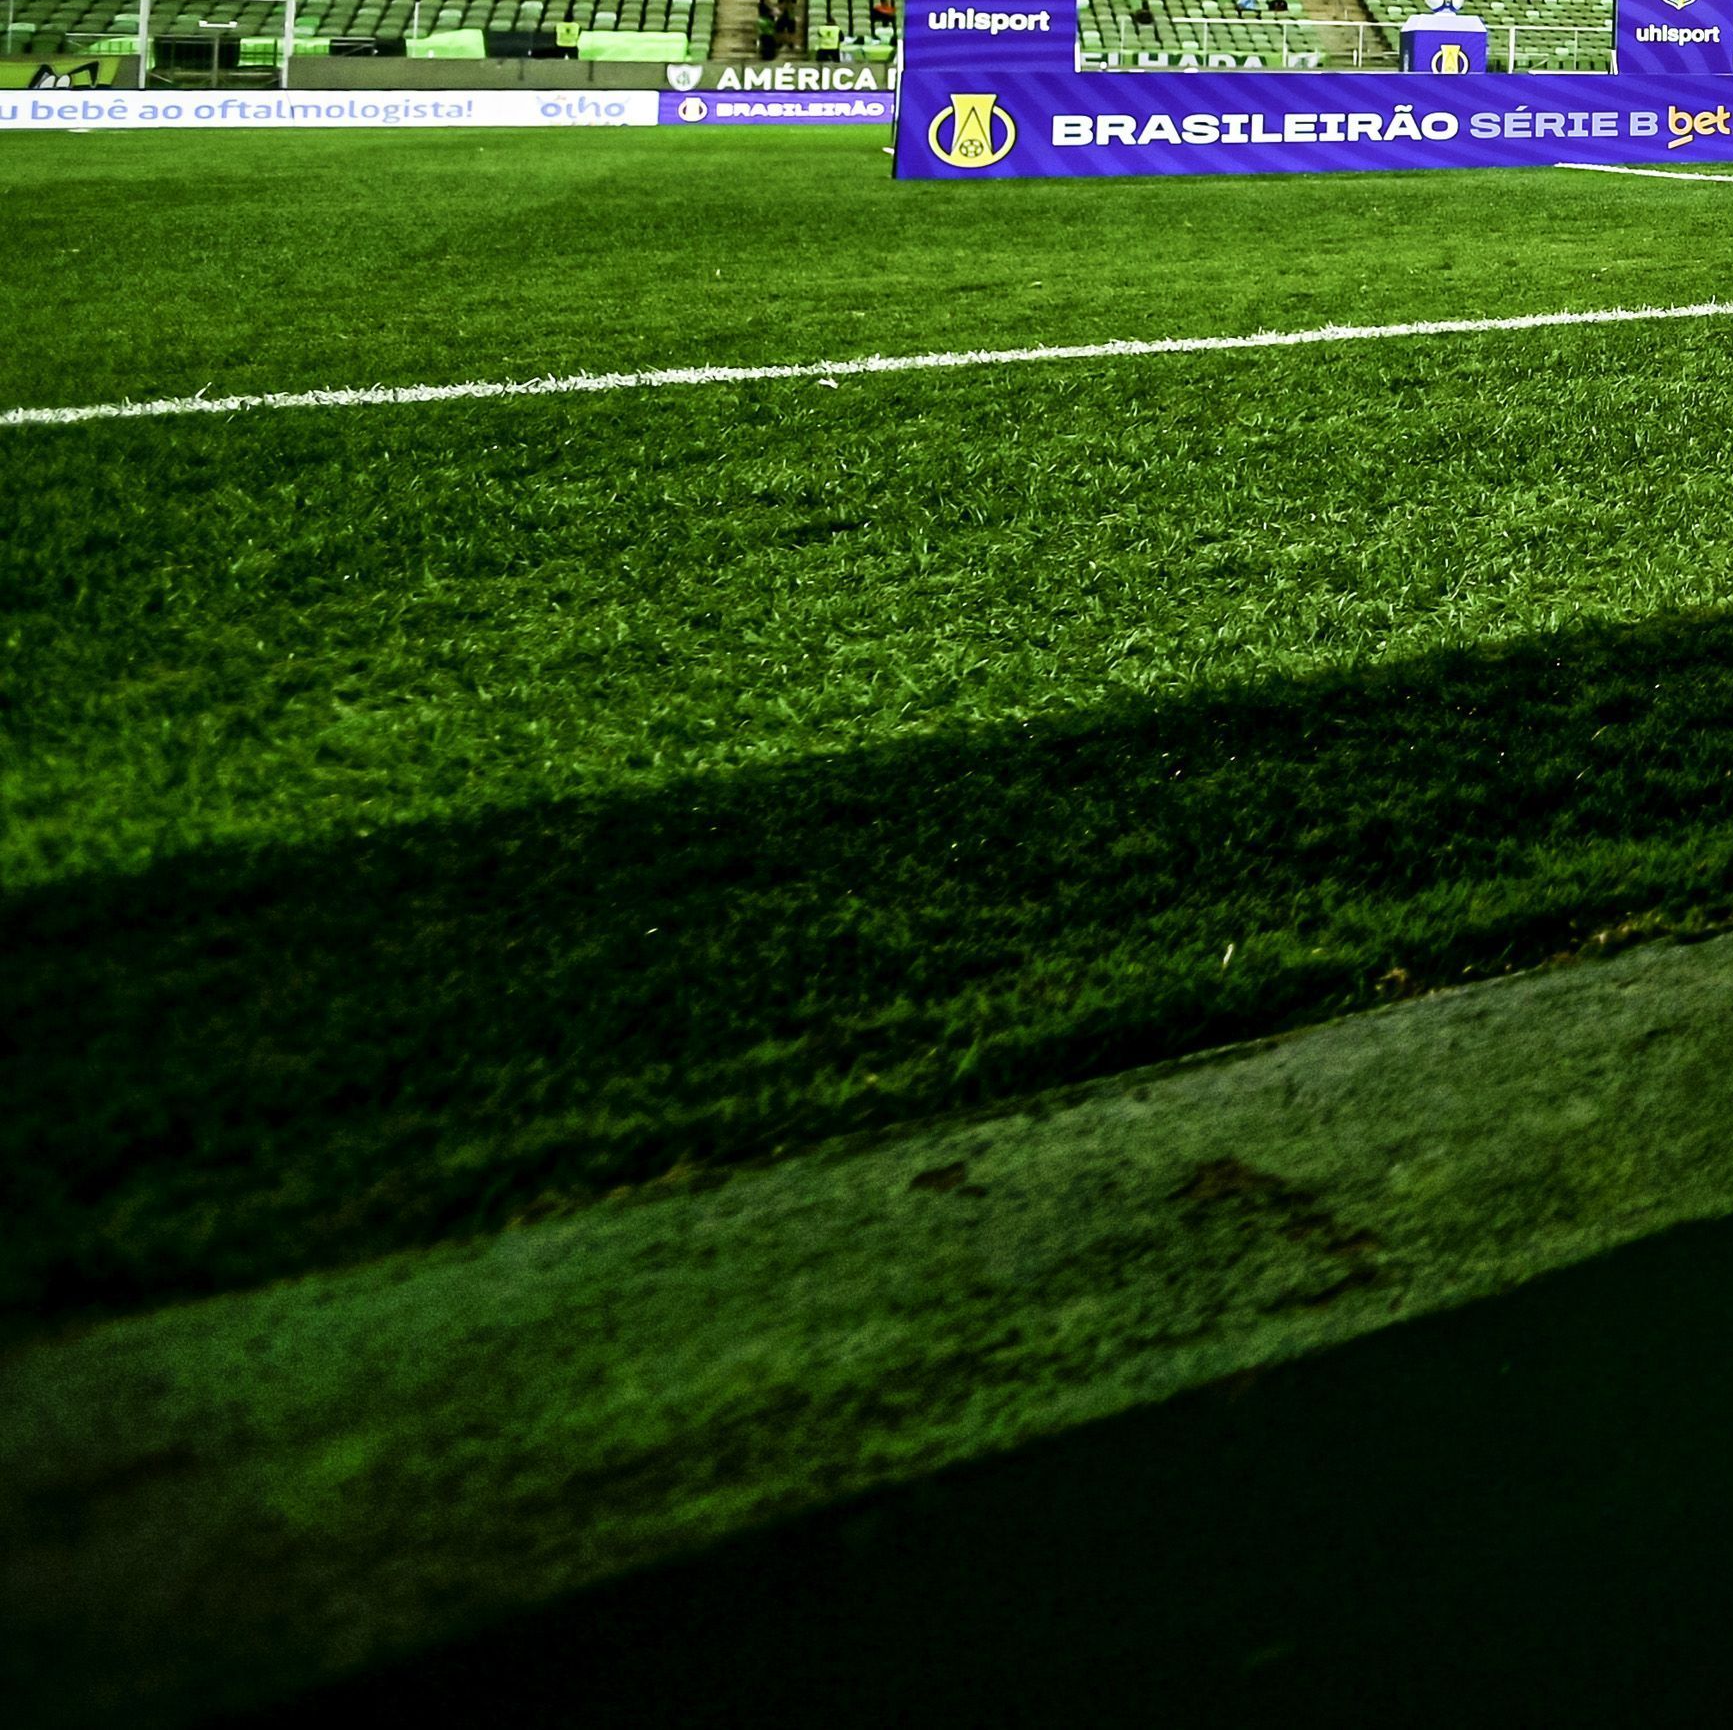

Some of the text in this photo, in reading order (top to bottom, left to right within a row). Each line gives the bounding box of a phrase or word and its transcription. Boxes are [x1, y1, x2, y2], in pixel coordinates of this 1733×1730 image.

[928, 7, 1051, 35] uhlsport
[1636, 24, 1720, 46] uhlsport
[716, 62, 878, 91] AMÉRICA
[31, 98, 128, 120] bebê
[139, 104, 182, 120] ao
[194, 99, 473, 123] oftalmologista!
[716, 99, 885, 117] BRASILEIRÃO
[1052, 104, 1460, 146] BRASILEIRÃO
[1469, 105, 1618, 139] SÉRIE
[1629, 112, 1658, 137] B
